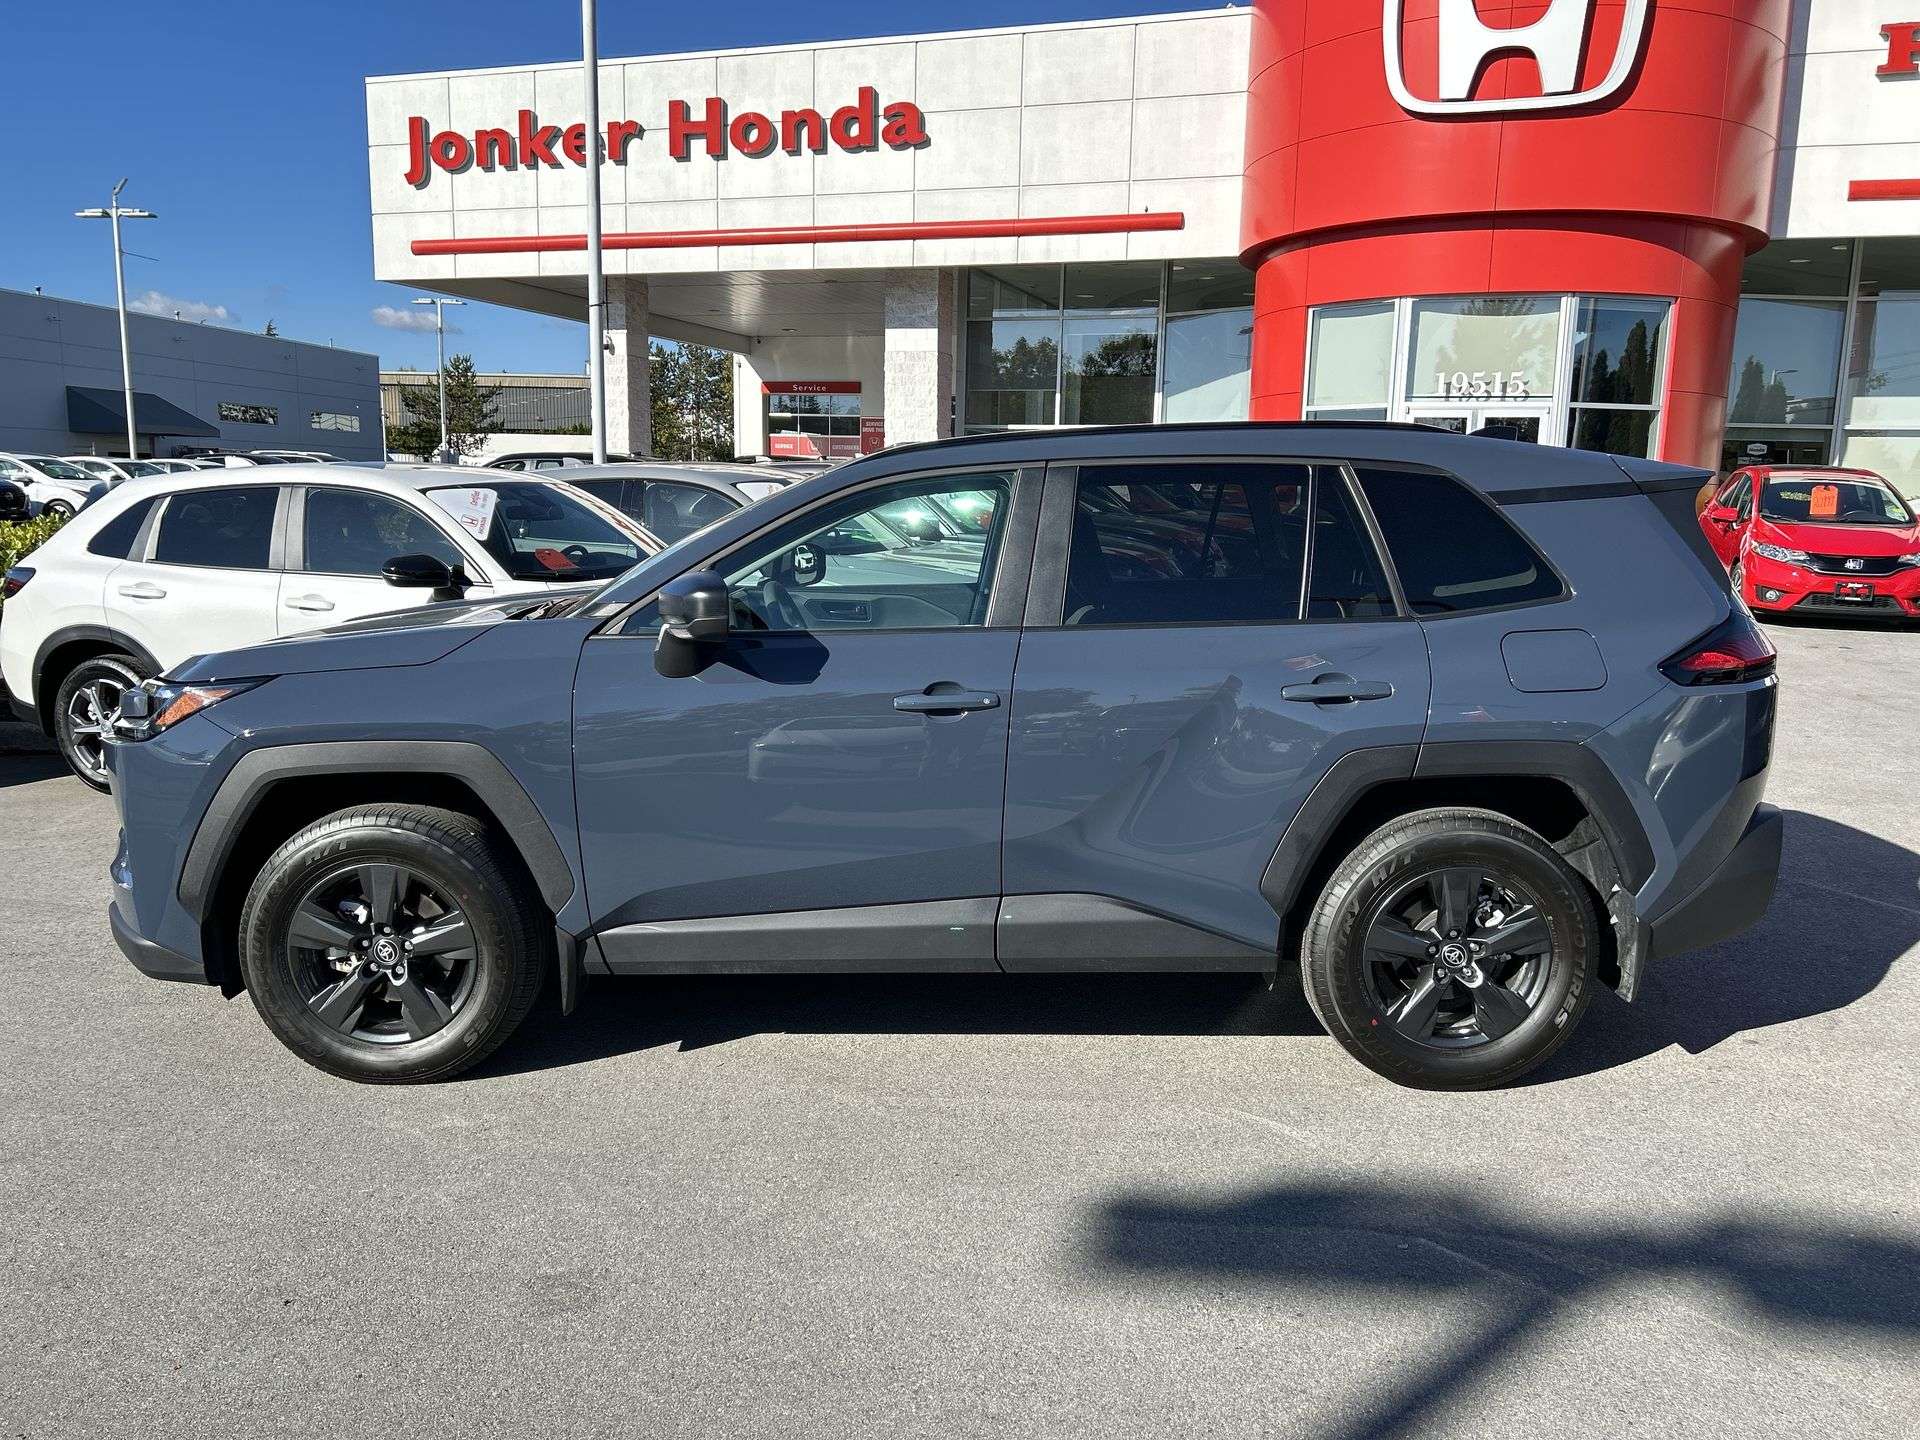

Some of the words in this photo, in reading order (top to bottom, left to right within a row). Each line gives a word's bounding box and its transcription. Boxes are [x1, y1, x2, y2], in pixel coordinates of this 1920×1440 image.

[405, 109, 643, 187] Jonker
[668, 86, 928, 159] Honda
[792, 384, 827, 392] Service
[1435, 370, 1526, 396] 19515
